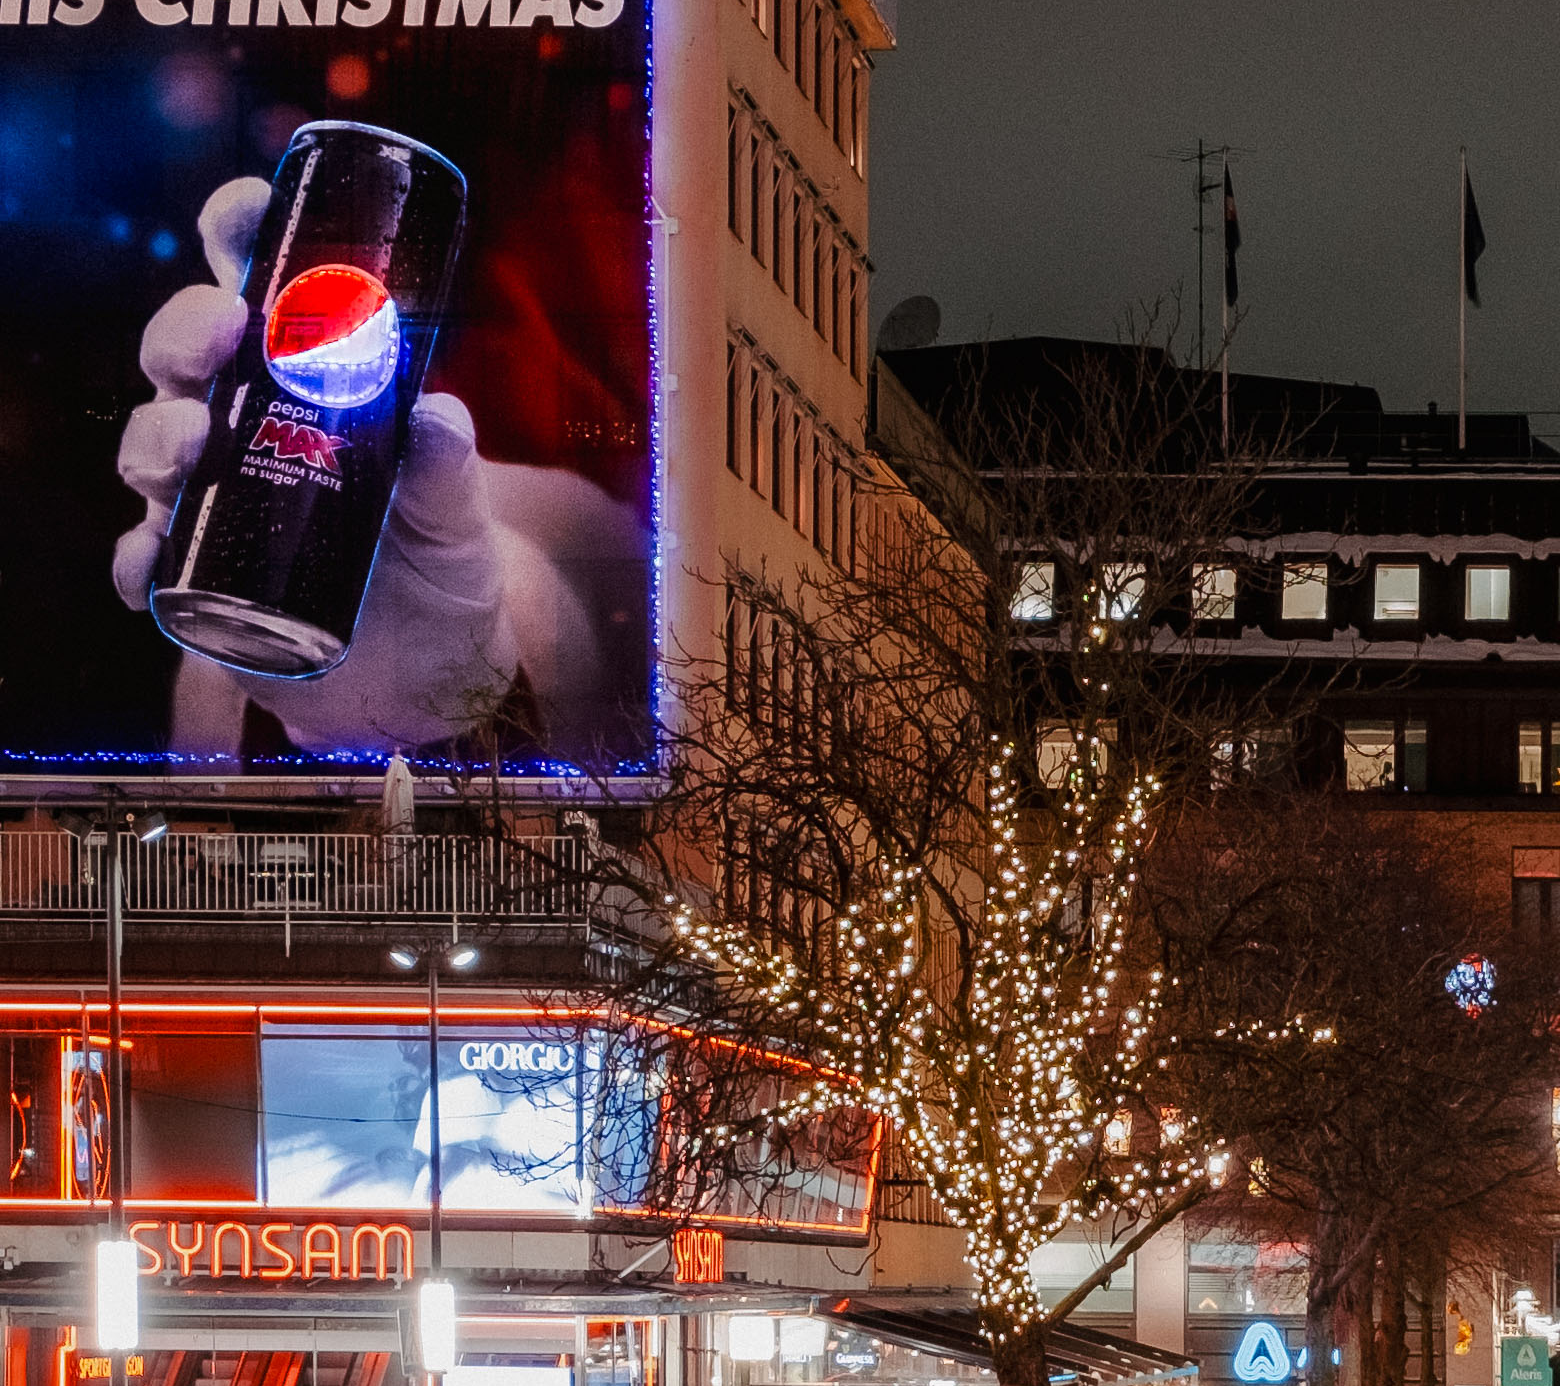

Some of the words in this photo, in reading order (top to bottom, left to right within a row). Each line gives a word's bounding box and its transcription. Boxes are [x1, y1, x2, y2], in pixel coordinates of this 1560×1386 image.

[268, 401, 321, 423] pepsi
[249, 416, 353, 475] MAX
[240, 466, 256, 476] no
[259, 469, 300, 486] sugar
[243, 454, 306, 477] MAXIMUM
[308, 469, 343, 492] TASTE
[128, 1220, 414, 1281] SYNSAM
[674, 1229, 724, 1283] SYNSAM
[1510, 1368, 1543, 1382] Aleris
